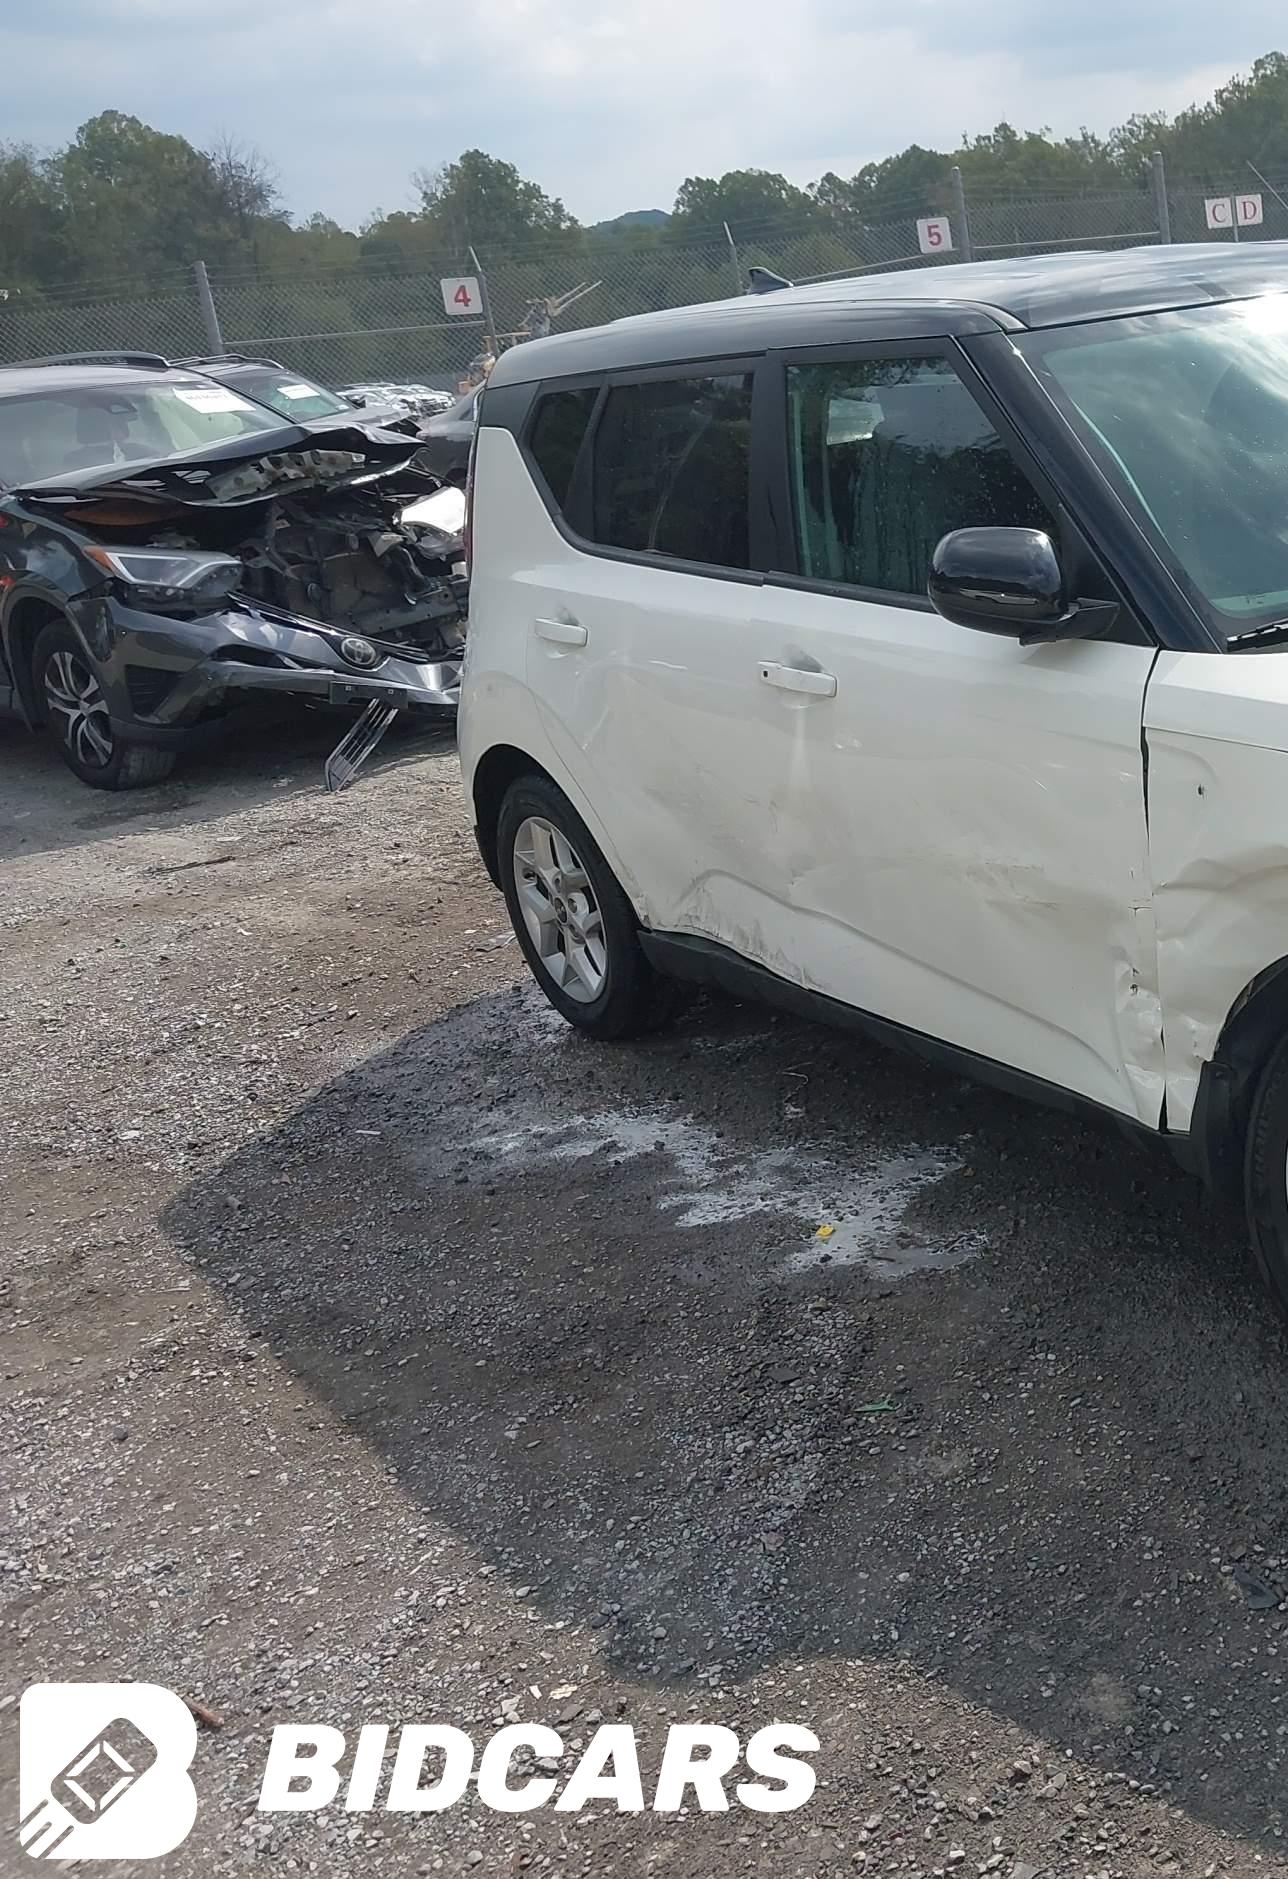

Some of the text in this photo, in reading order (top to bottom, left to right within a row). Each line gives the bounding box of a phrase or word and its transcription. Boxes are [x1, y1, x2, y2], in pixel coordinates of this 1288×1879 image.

[1212, 200, 1257, 223] C D
[927, 223, 942, 247] 5
[454, 284, 472, 308] 4
